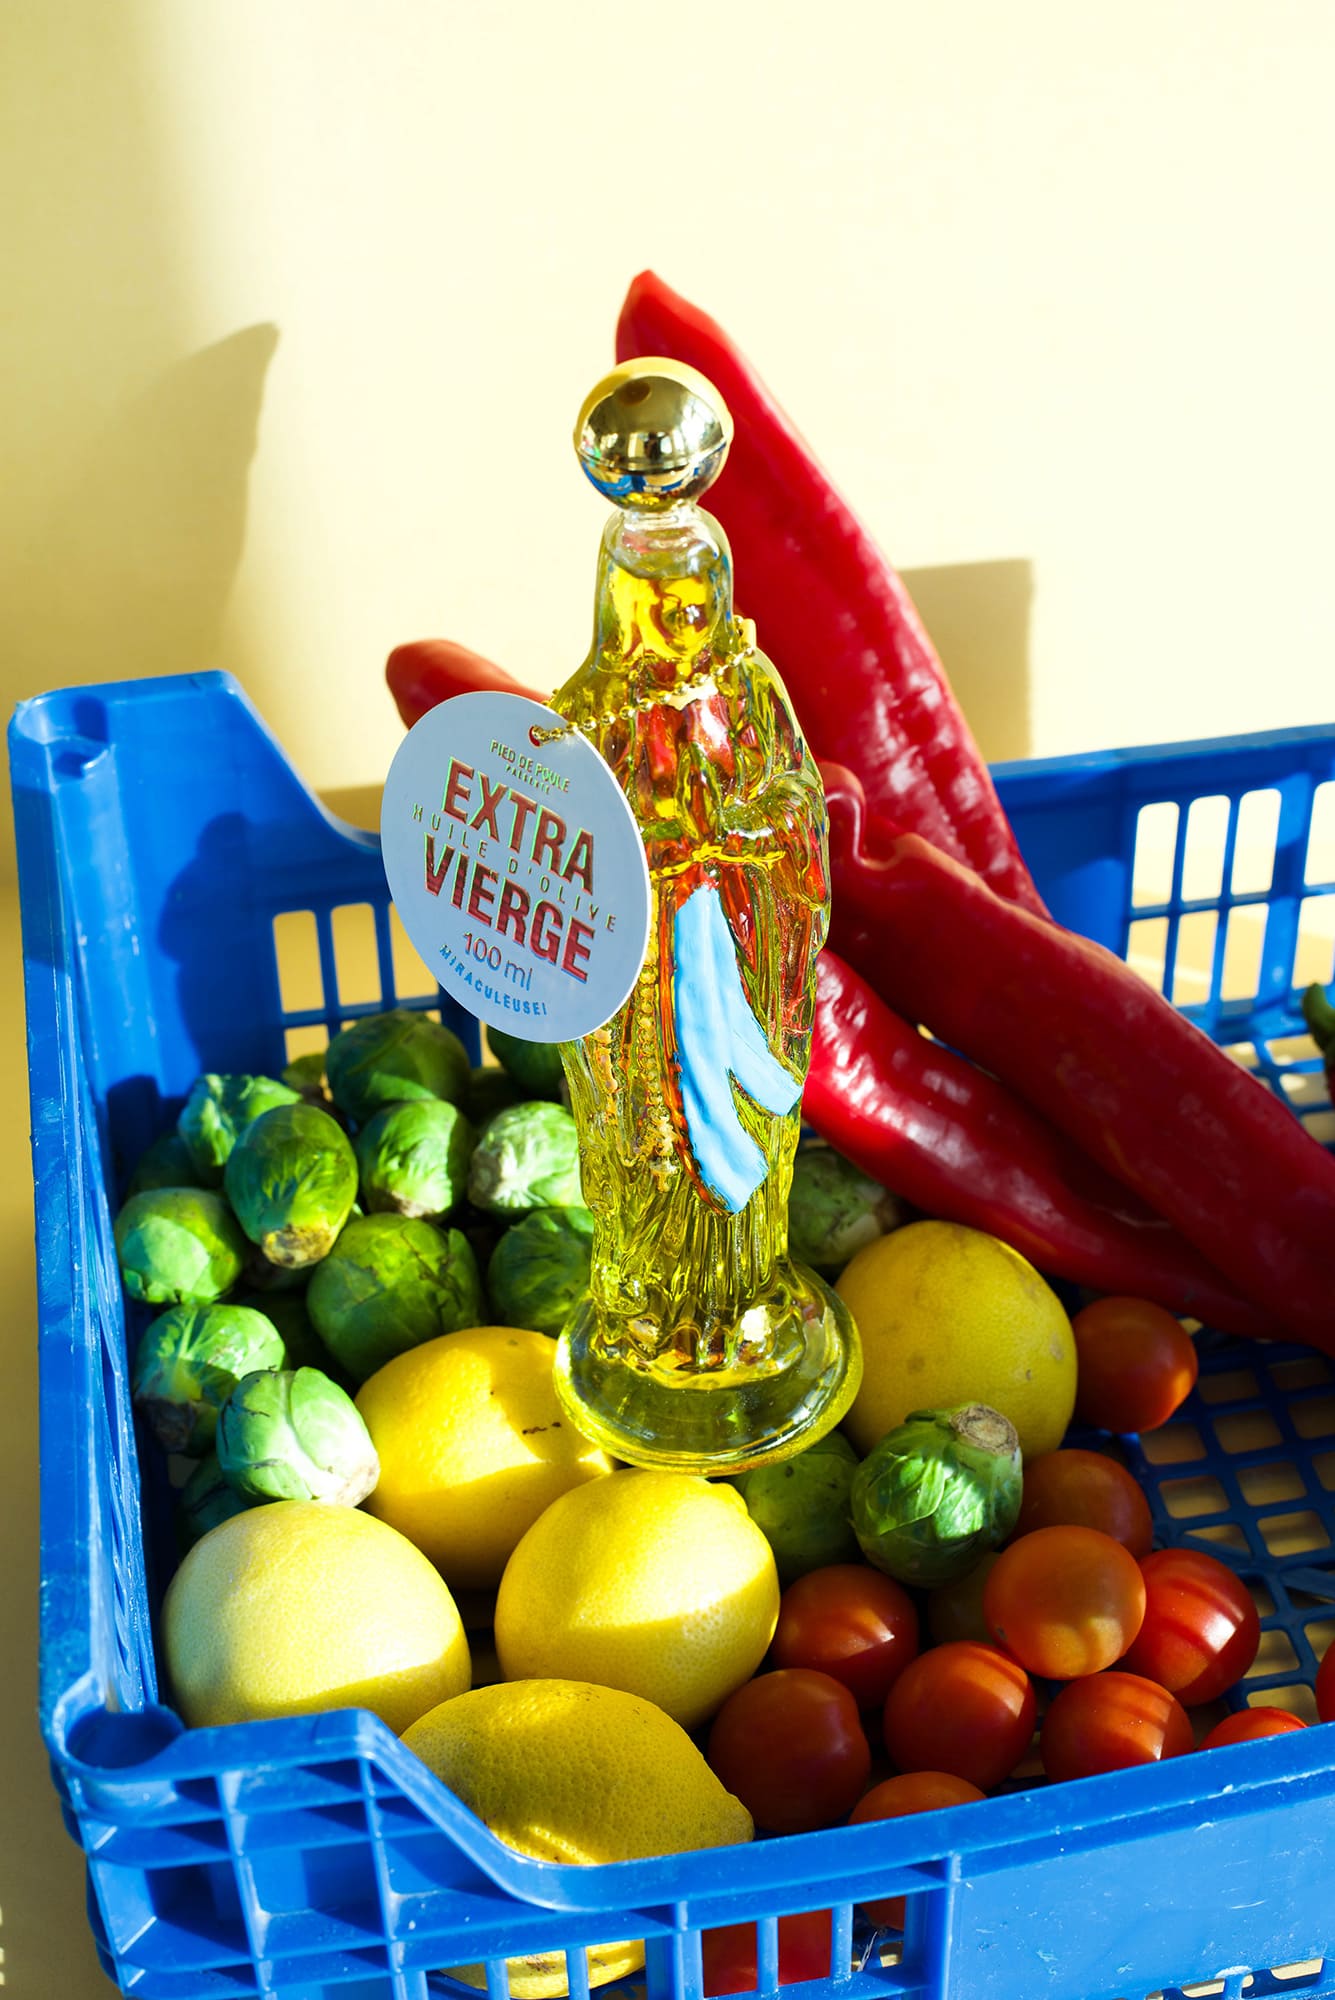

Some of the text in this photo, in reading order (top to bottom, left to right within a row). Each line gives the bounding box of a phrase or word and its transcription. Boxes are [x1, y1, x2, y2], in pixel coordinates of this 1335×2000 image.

[442, 756, 594, 896] EXTRA
[490, 739, 570, 793] PIED DE POULE
[412, 803, 616, 932] HUILE D'OLIVE
[424, 831, 596, 984] VIERGE
[463, 931, 533, 991] 100 ml
